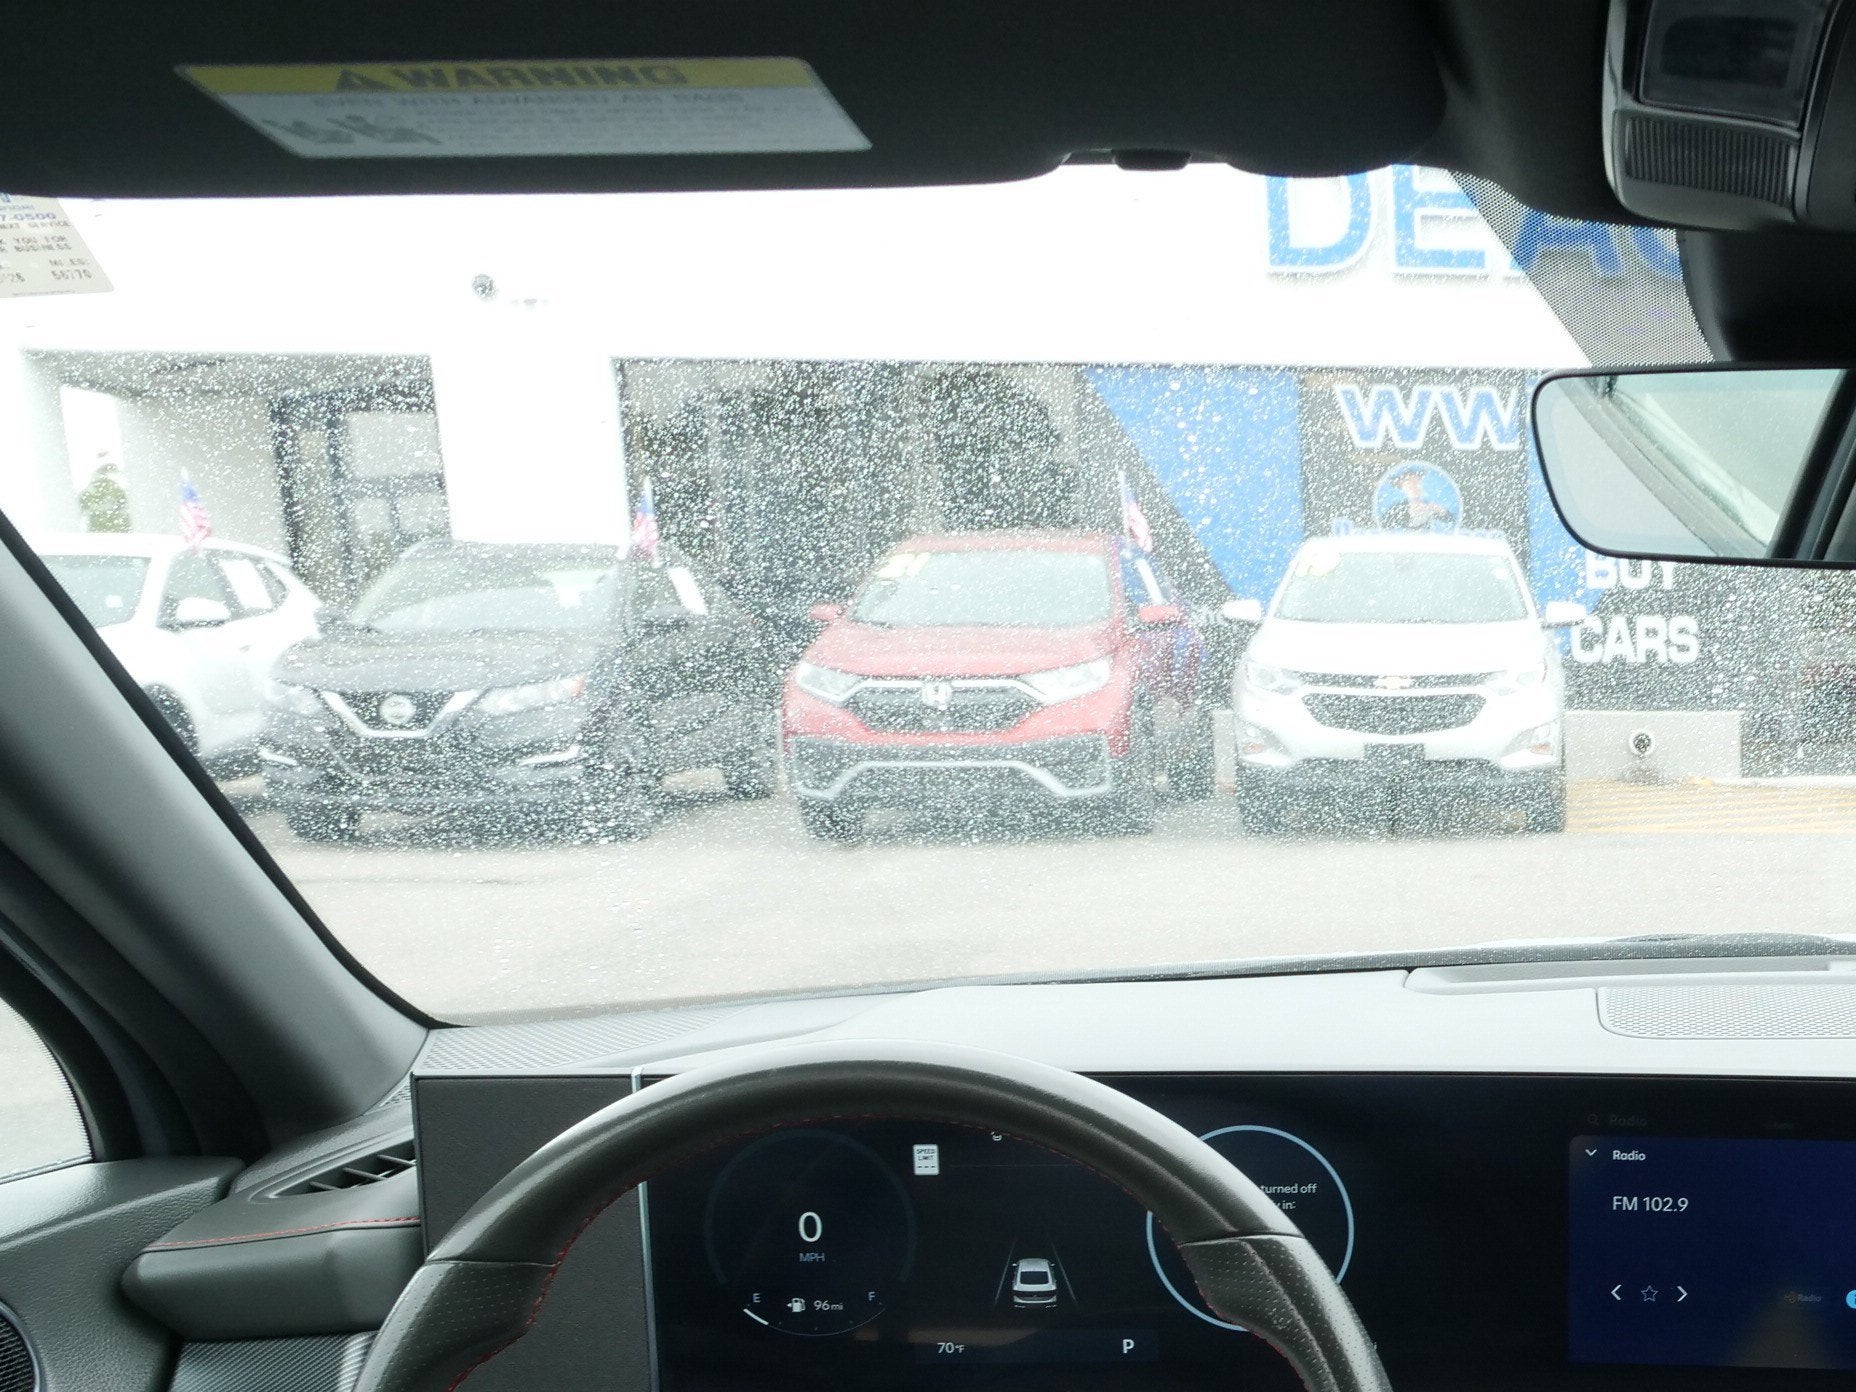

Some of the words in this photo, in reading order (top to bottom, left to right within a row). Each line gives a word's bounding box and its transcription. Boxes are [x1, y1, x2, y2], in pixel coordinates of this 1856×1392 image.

[391, 65, 687, 88] WARNING
[1570, 615, 1699, 665] CARS
[1612, 1150, 1646, 1161] Radio
[1300, 1182, 1318, 1194] off
[1612, 1196, 1638, 1211] FM
[1643, 1197, 1689, 1212] 102.9
[798, 1211, 823, 1243] 0
[799, 1253, 826, 1262] MPH
[752, 1293, 761, 1303] E
[868, 1291, 876, 1301] F
[1122, 1339, 1135, 1353] P
